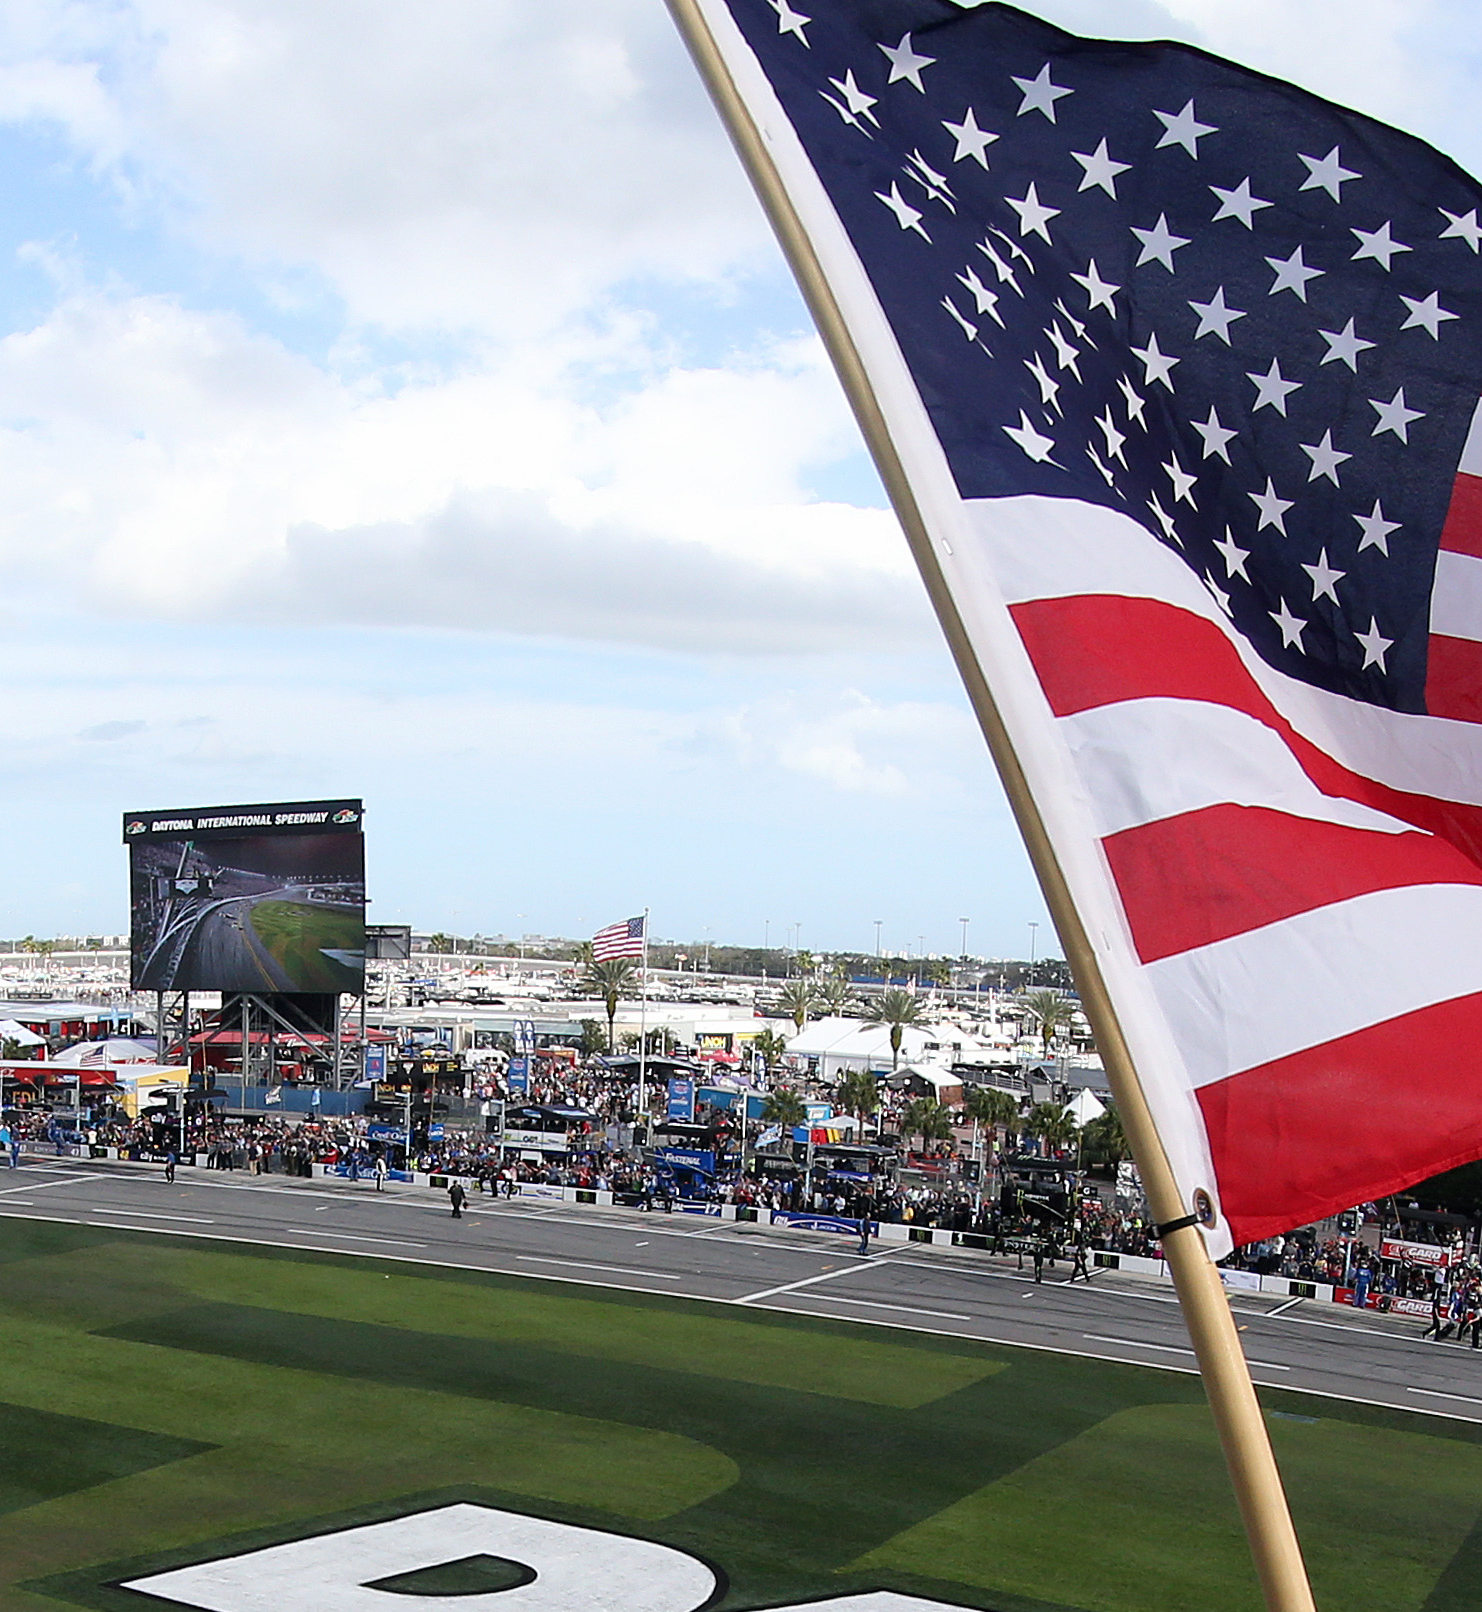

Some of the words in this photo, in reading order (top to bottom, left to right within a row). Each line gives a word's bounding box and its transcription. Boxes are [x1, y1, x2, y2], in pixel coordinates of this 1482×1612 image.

[151, 819, 194, 831] DAYTONA
[196, 815, 273, 829] INTERNATIONAL
[274, 811, 329, 825] SPEEDWAY
[701, 1037, 726, 1048] UNOH
[704, 1203, 718, 1215] 17
